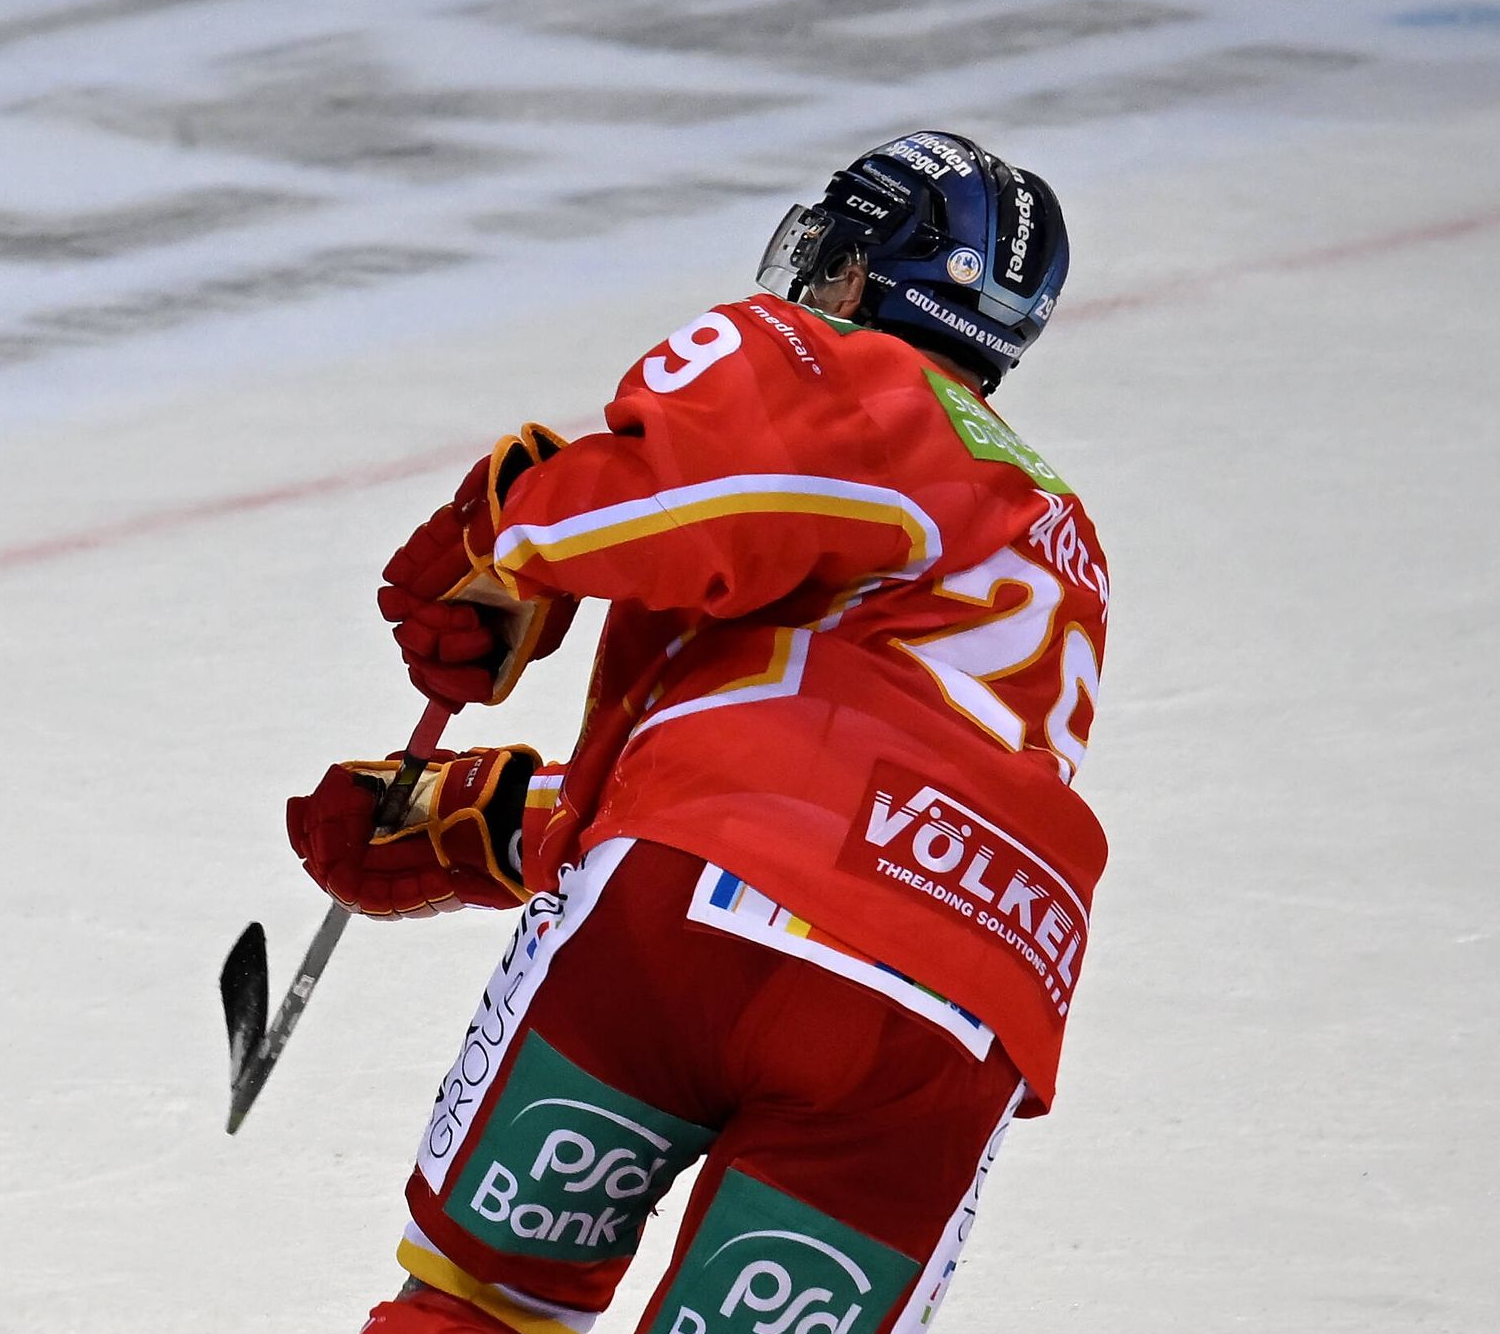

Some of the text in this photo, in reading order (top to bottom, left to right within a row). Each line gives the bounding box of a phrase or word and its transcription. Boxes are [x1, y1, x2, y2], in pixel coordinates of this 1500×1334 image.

[846, 194, 890, 220] CCM
[1005, 188, 1034, 283] Spiegel
[868, 271, 897, 288] CCM
[865, 786, 1088, 989] VÖLKEL
[877, 857, 1046, 976] THREADING SOLUTIONS
[429, 971, 524, 1158] GROUP
[469, 1160, 629, 1246] Bank
[531, 1127, 666, 1200] psd
